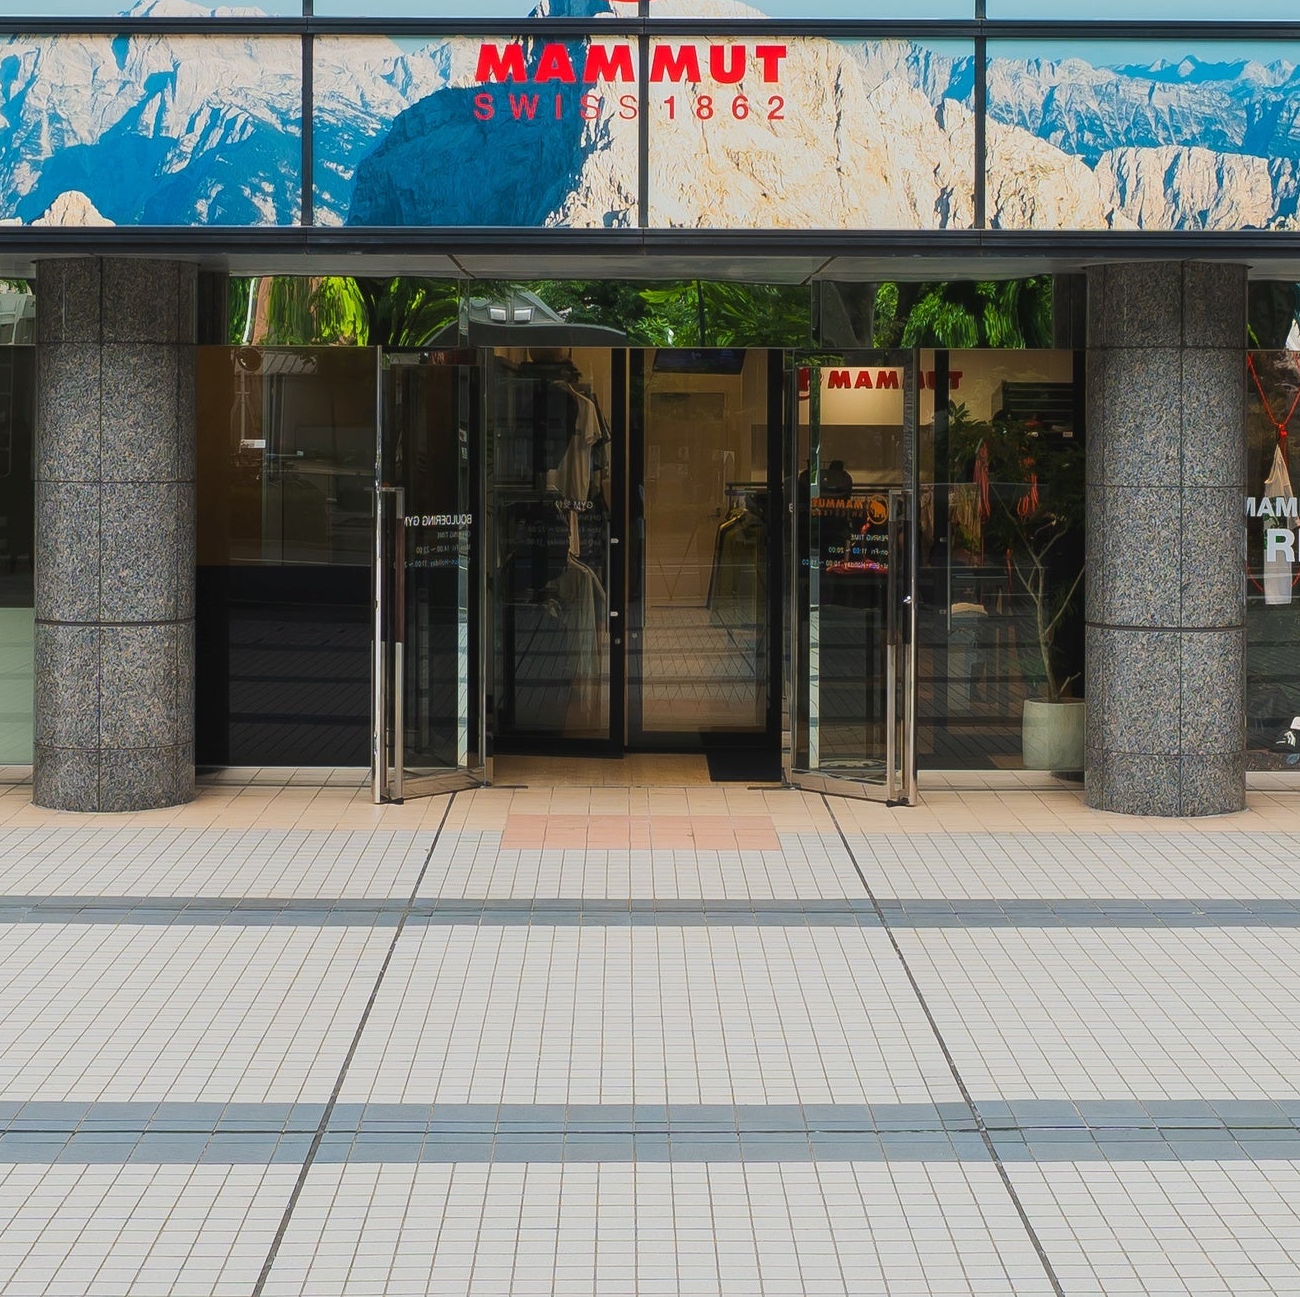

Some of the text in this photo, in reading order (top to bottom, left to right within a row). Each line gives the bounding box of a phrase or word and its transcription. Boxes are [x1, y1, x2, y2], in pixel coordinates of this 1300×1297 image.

[474, 44, 787, 83] MAMMUT
[474, 93, 786, 121] SWISS 1862
